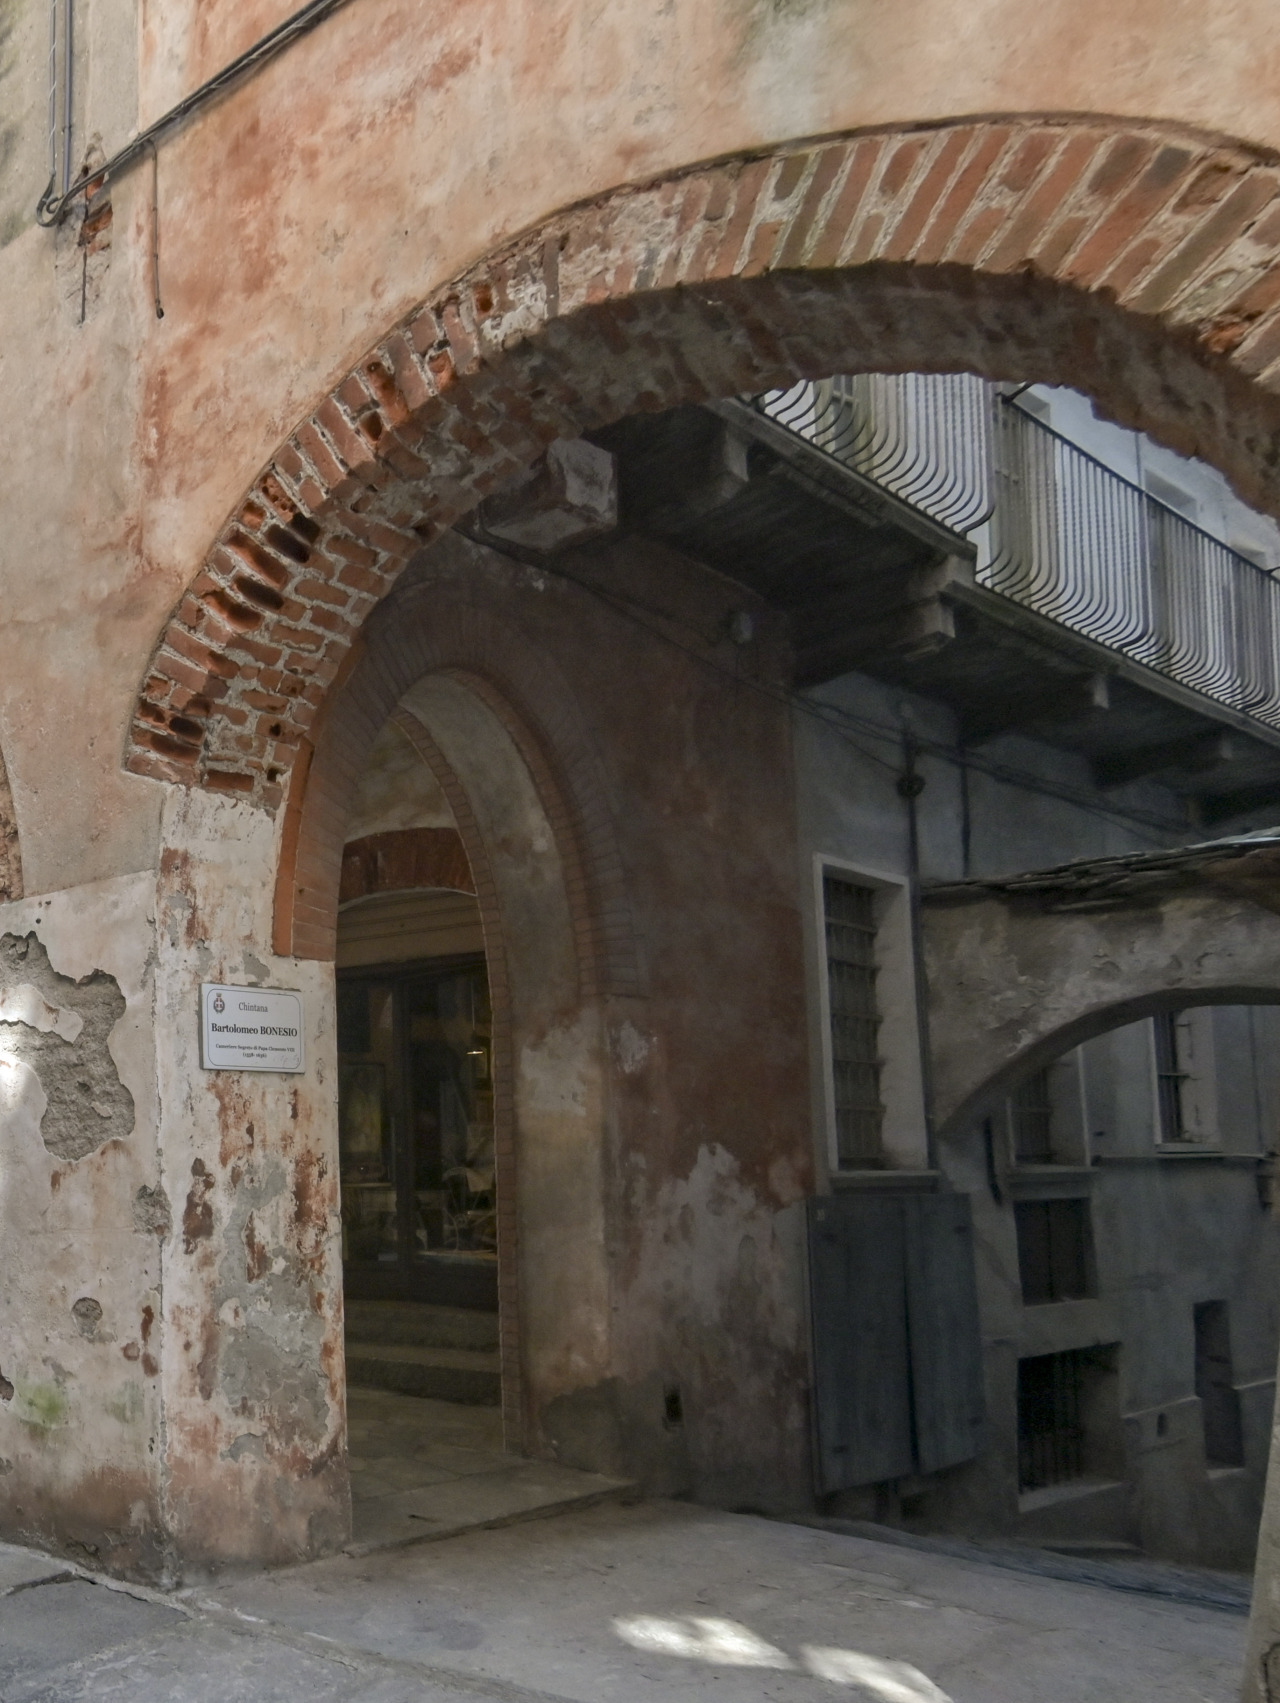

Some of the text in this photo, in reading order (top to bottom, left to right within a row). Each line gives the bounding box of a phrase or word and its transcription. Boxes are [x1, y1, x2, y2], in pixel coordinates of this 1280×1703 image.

[238, 1002, 268, 1013] Chintana
[211, 1023, 298, 1037] Bartolomeo BONESIO
